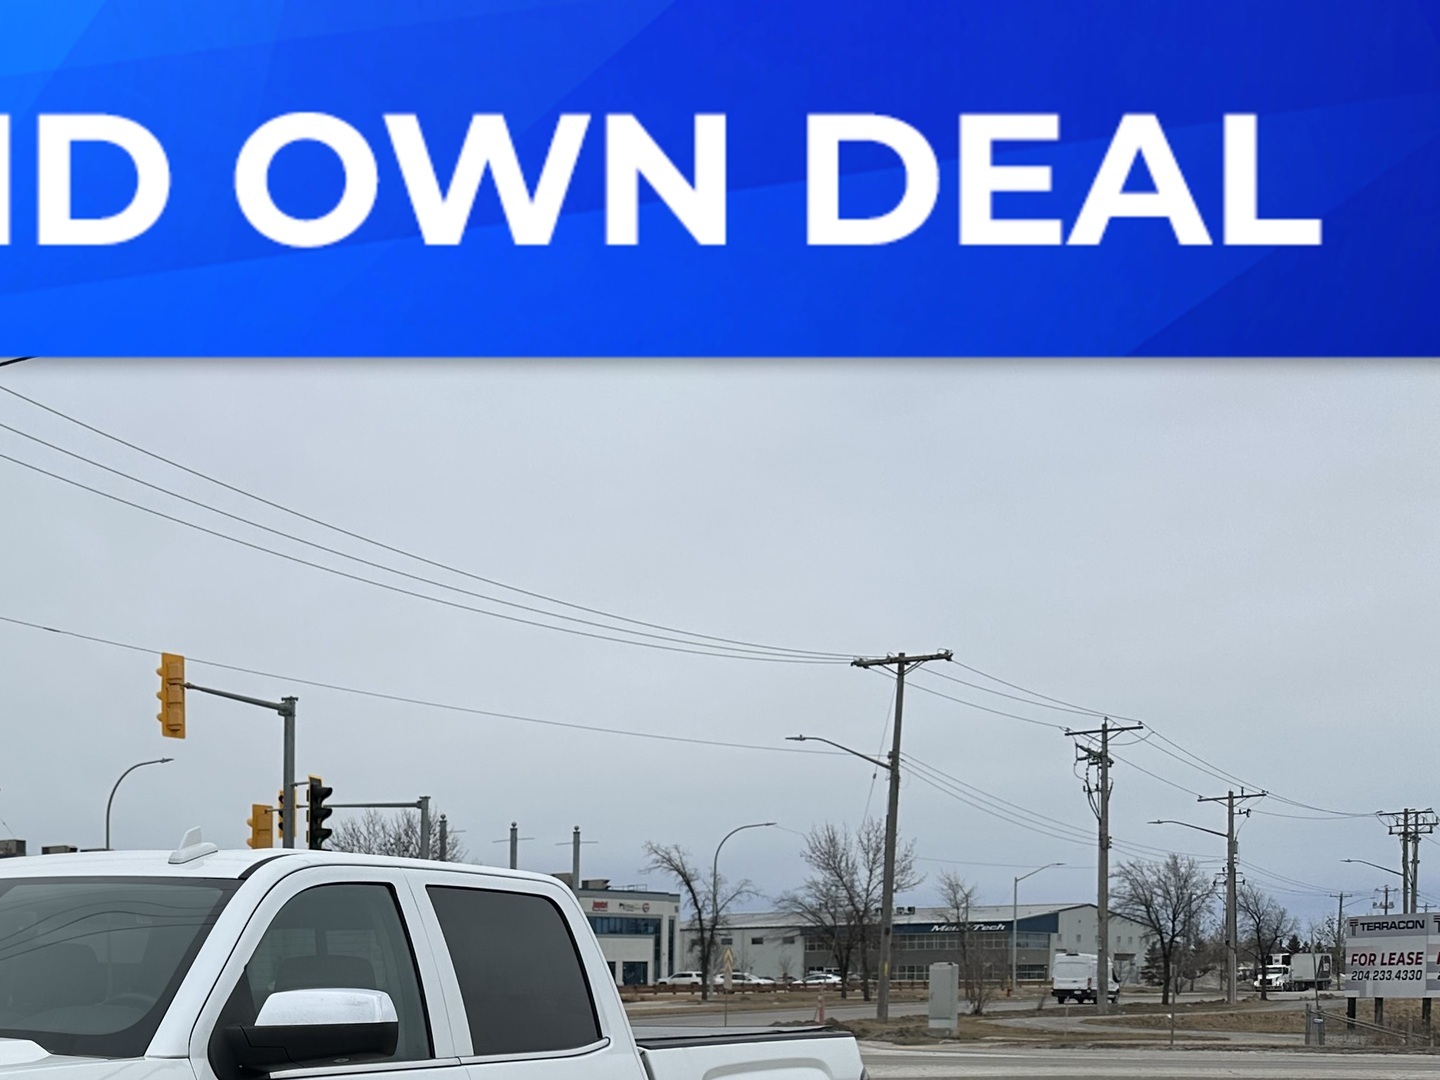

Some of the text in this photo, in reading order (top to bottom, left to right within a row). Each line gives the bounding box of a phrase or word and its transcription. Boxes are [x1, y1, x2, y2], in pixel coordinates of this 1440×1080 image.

[1359, 920, 1425, 931] TERRACON
[1350, 952, 1377, 967] FOR
[1380, 951, 1424, 966] LEASE
[1351, 969, 1423, 981] 204.233.4330
